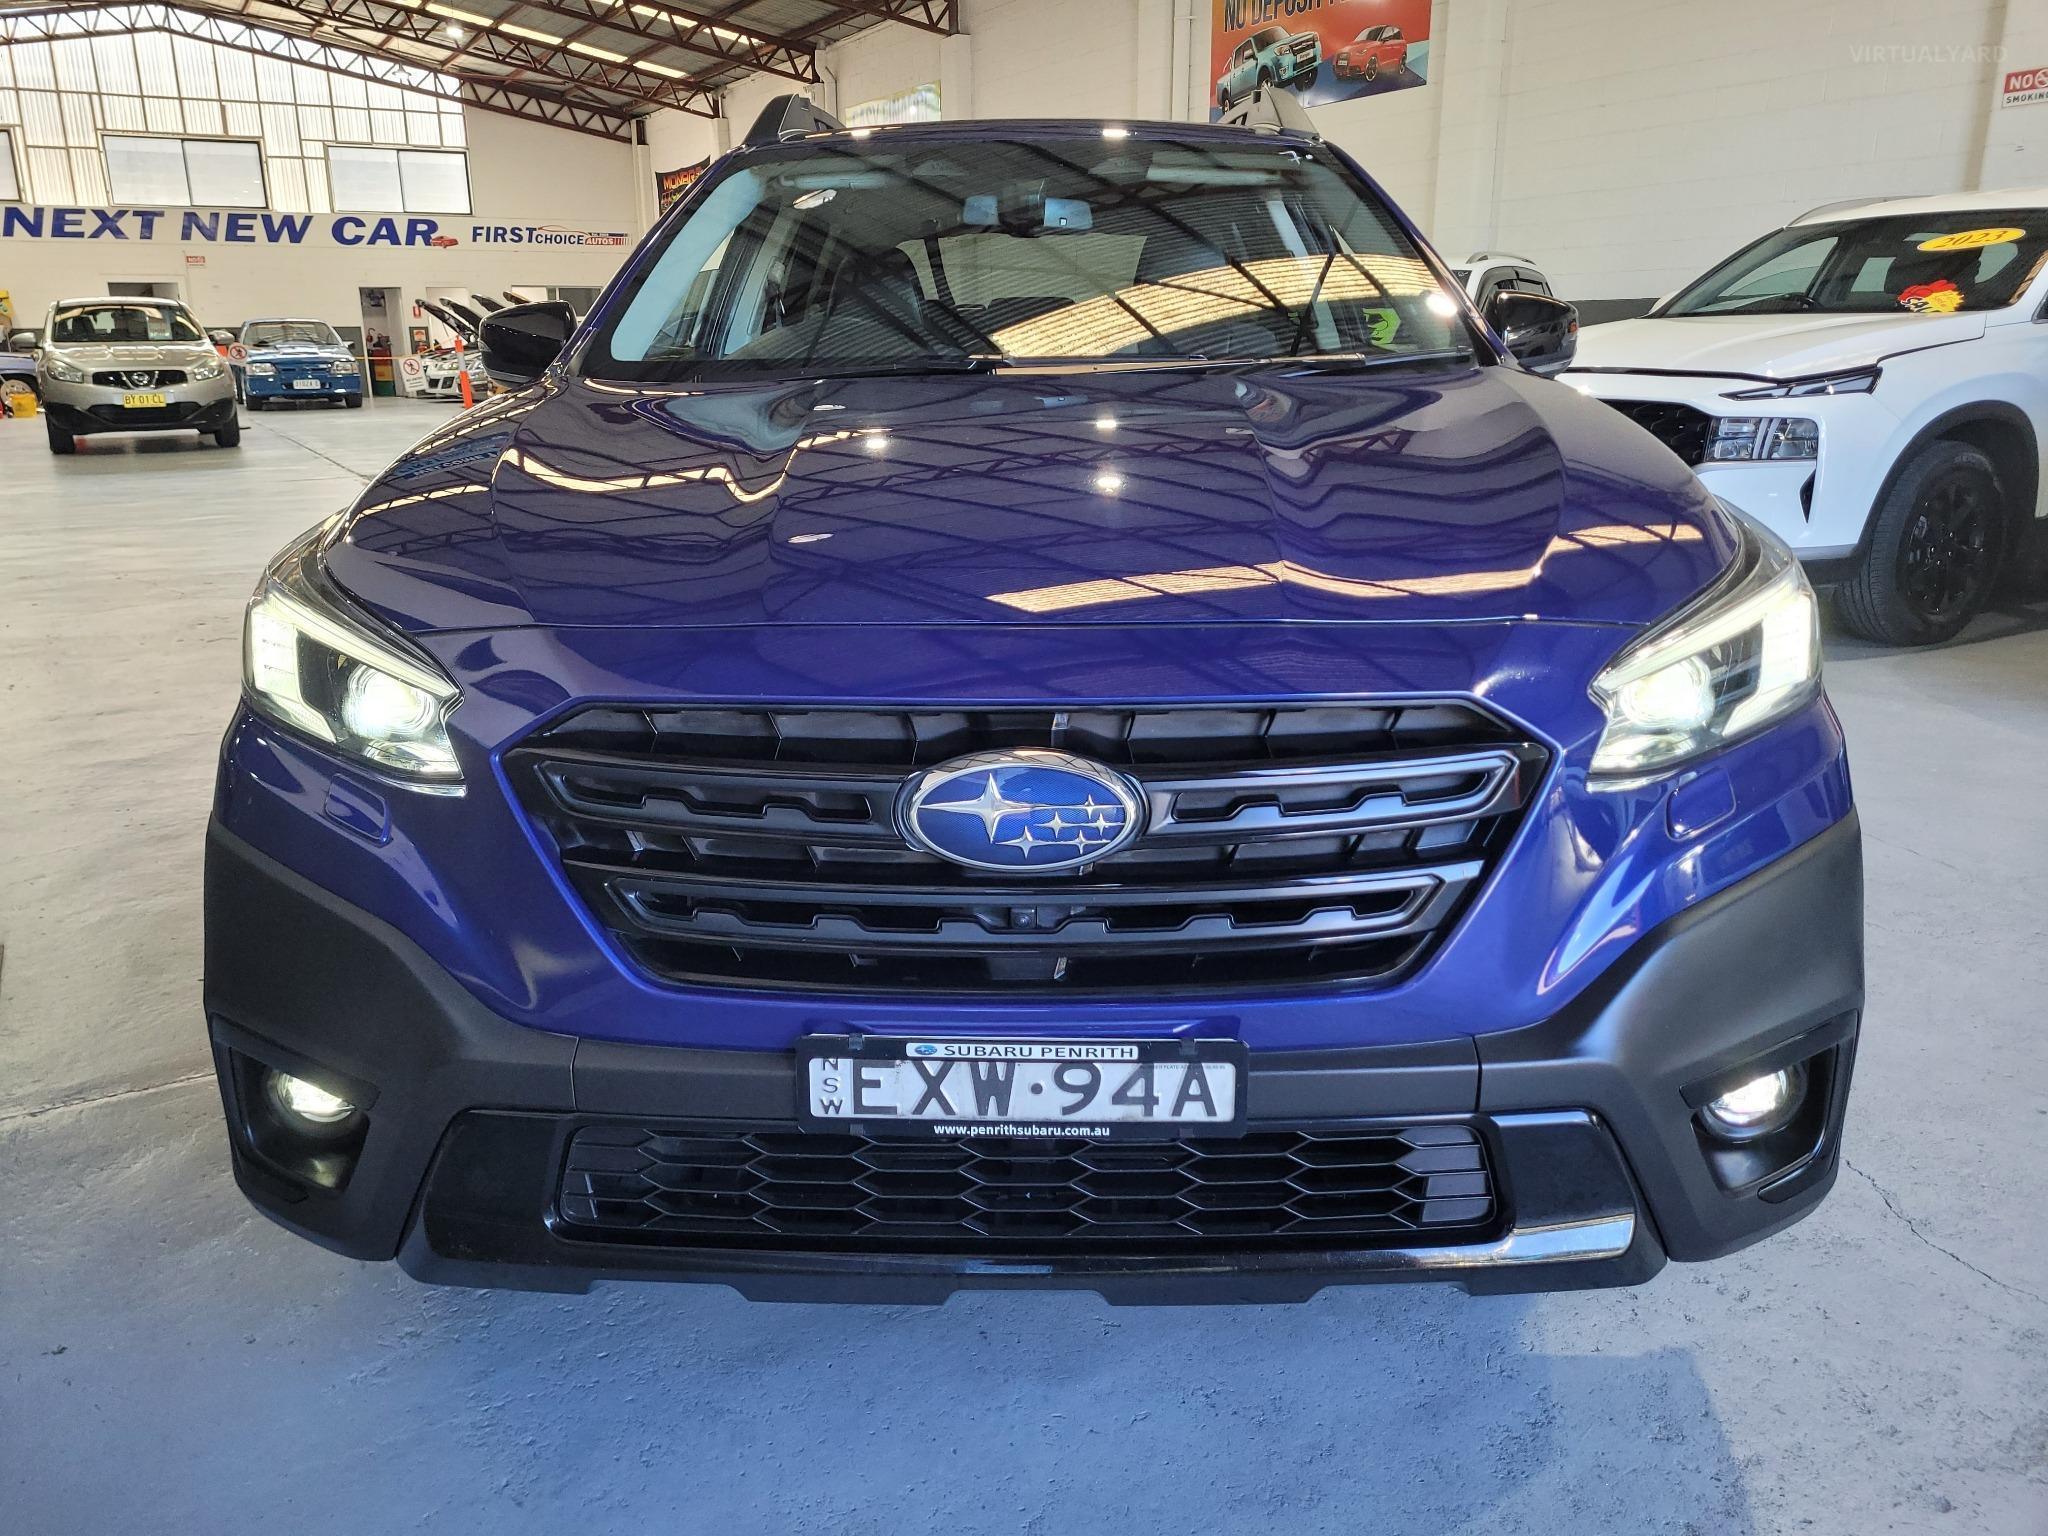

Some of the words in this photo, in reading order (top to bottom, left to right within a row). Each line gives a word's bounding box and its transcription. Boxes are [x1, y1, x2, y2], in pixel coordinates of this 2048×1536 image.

[2010, 74, 2034, 90] NO
[3, 207, 165, 240] NEXT
[181, 212, 314, 243] NEW
[331, 216, 439, 246] CAR
[472, 226, 537, 243] FIRST
[535, 233, 584, 245] CHOICE
[586, 237, 614, 245] AUTOS
[1933, 230, 2008, 248] 2023
[943, 1045, 1033, 1058] SUBARU
[1041, 1046, 1134, 1059] PENRITH
[933, 1124, 1110, 1137] www.penrithsubaru.com.au
